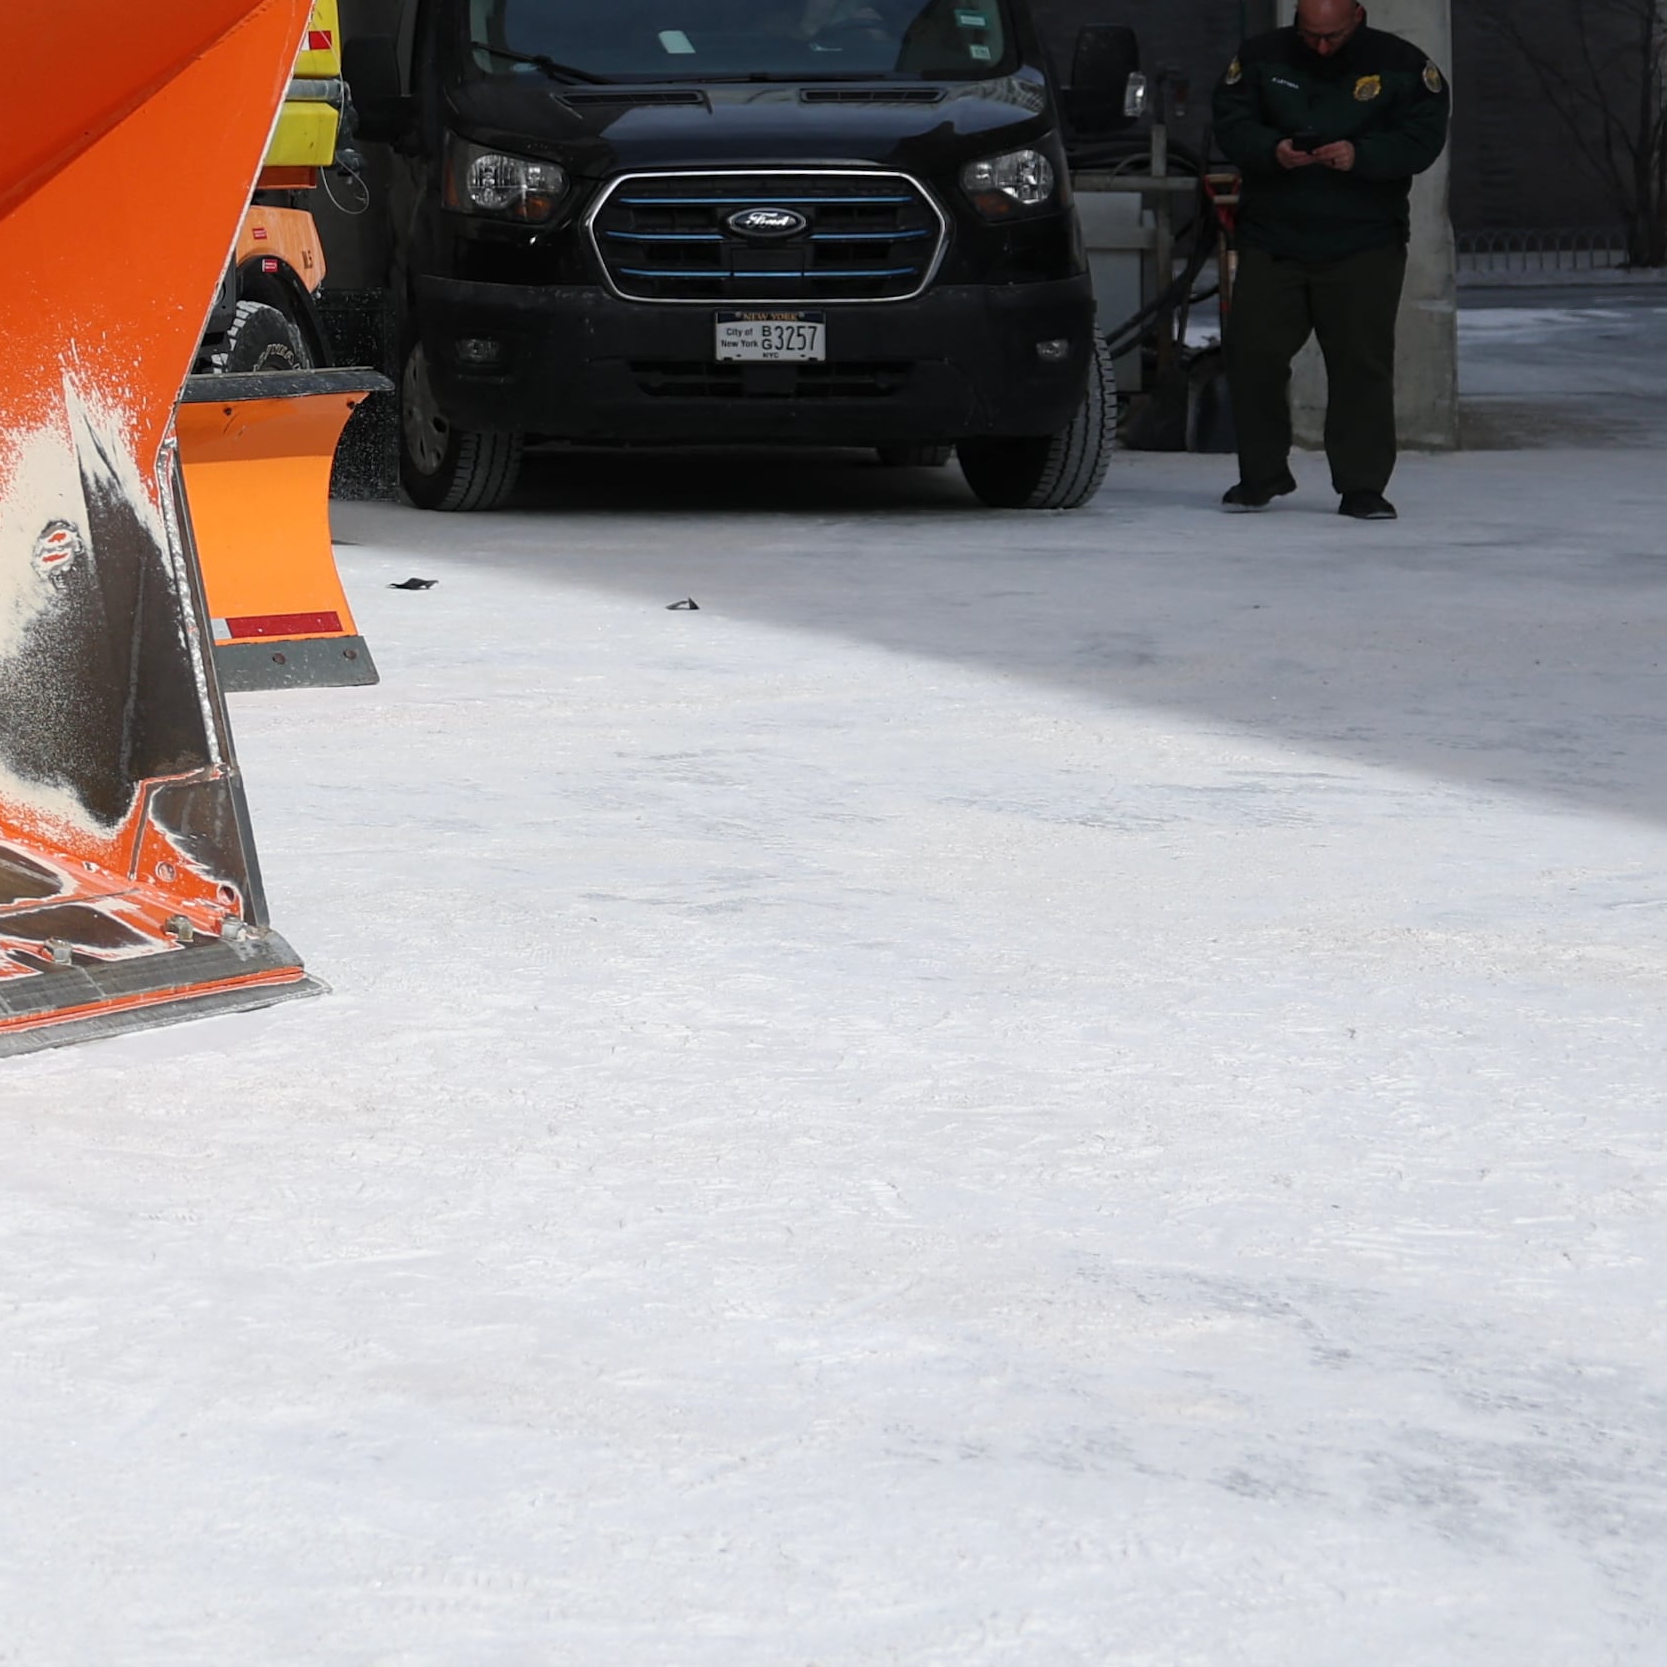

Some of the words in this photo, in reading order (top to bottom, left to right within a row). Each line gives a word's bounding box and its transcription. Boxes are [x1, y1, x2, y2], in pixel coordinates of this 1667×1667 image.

[745, 312, 768, 321] NEW
[772, 312, 797, 321] YORK
[726, 328, 742, 337] City
[774, 325, 817, 350] 3257
